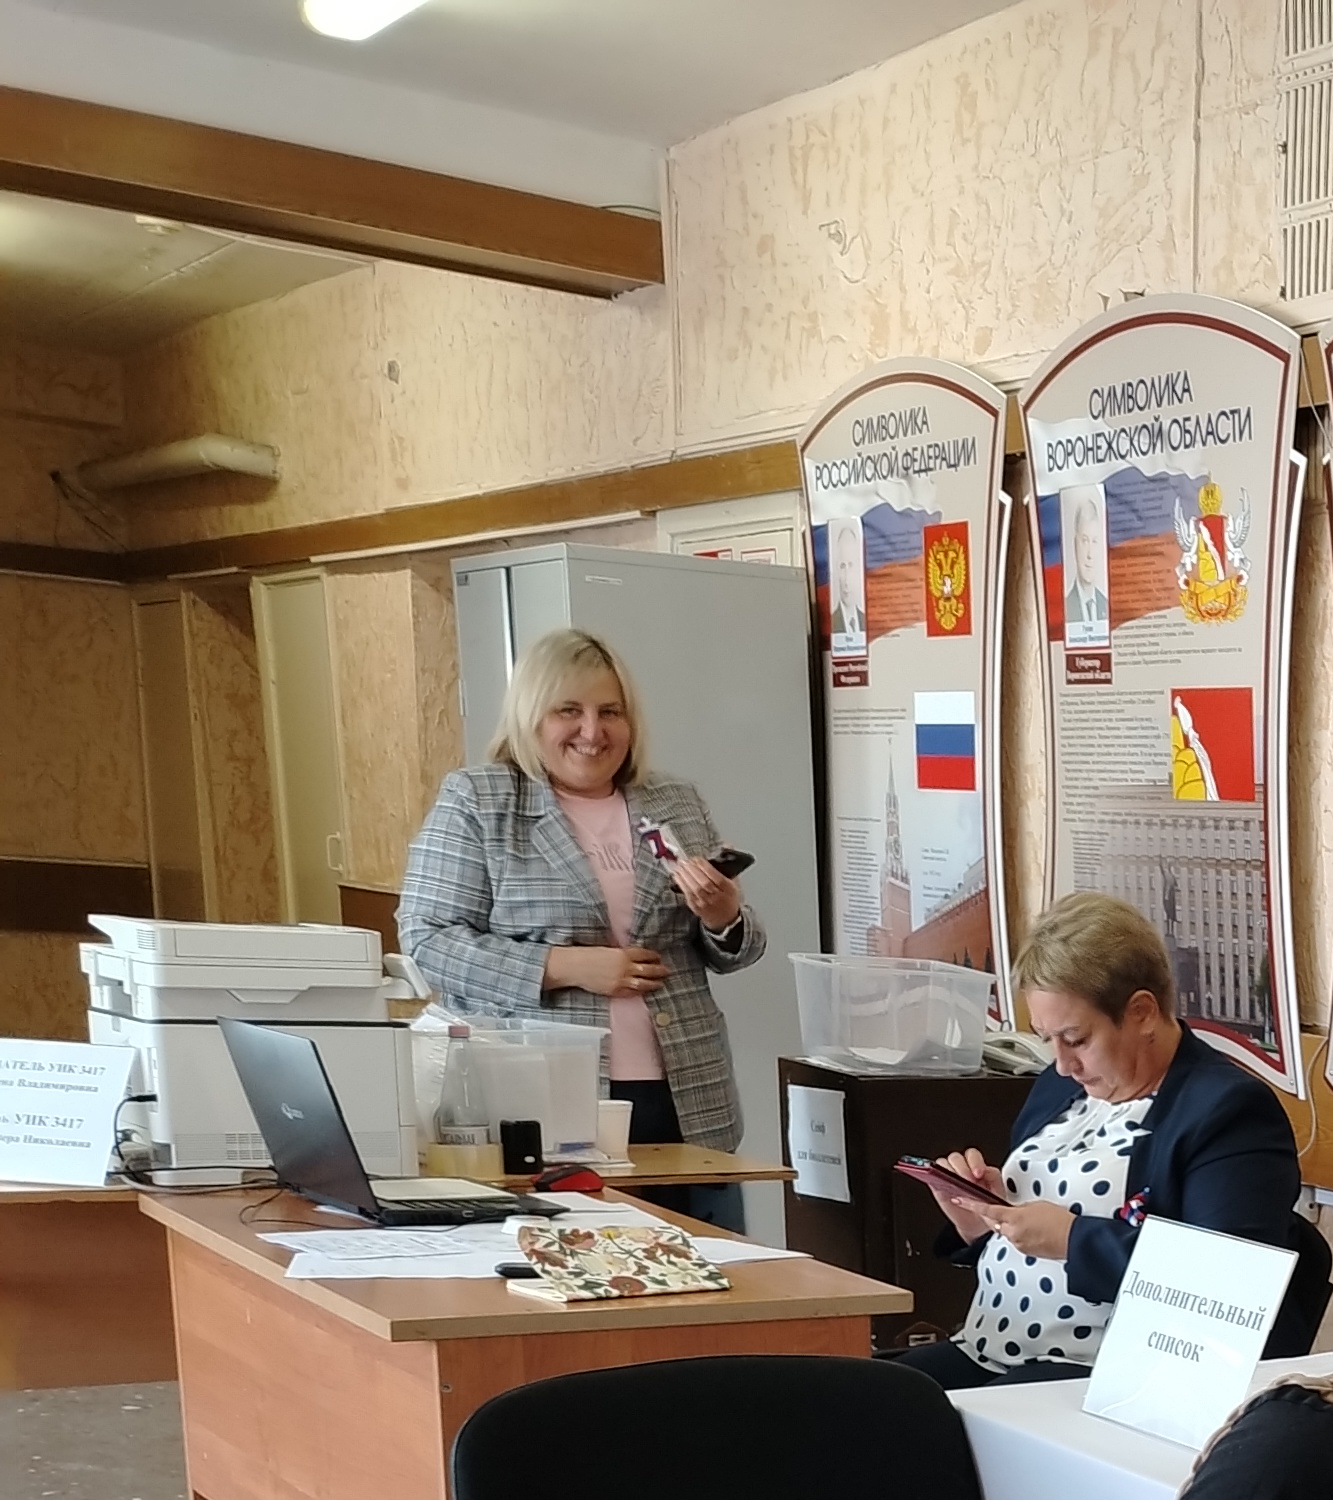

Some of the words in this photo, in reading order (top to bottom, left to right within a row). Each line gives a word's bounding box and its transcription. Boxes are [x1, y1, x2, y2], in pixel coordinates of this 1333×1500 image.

[1088, 370, 1193, 420] СИМВОЛИКА
[852, 406, 930, 447] СИМВОЛИКА
[1047, 416, 1164, 473] ВОРОНЕЖСКОЙ
[1168, 407, 1253, 453] ОБЛАСТИ
[815, 447, 899, 491] РОССИЙСКОЙ
[901, 437, 977, 478] ФЕДЕРАЦИИ
[17, 1078, 98, 1092] Владимировна
[79, 1066, 106, 1076] 3417
[15, 1113, 49, 1127] УИК
[51, 1116, 84, 1129] 3417
[23, 1135, 91, 1148] Николаевна
[1122, 1270, 1267, 1331] Дополнительный
[1147, 1330, 1204, 1363] список
